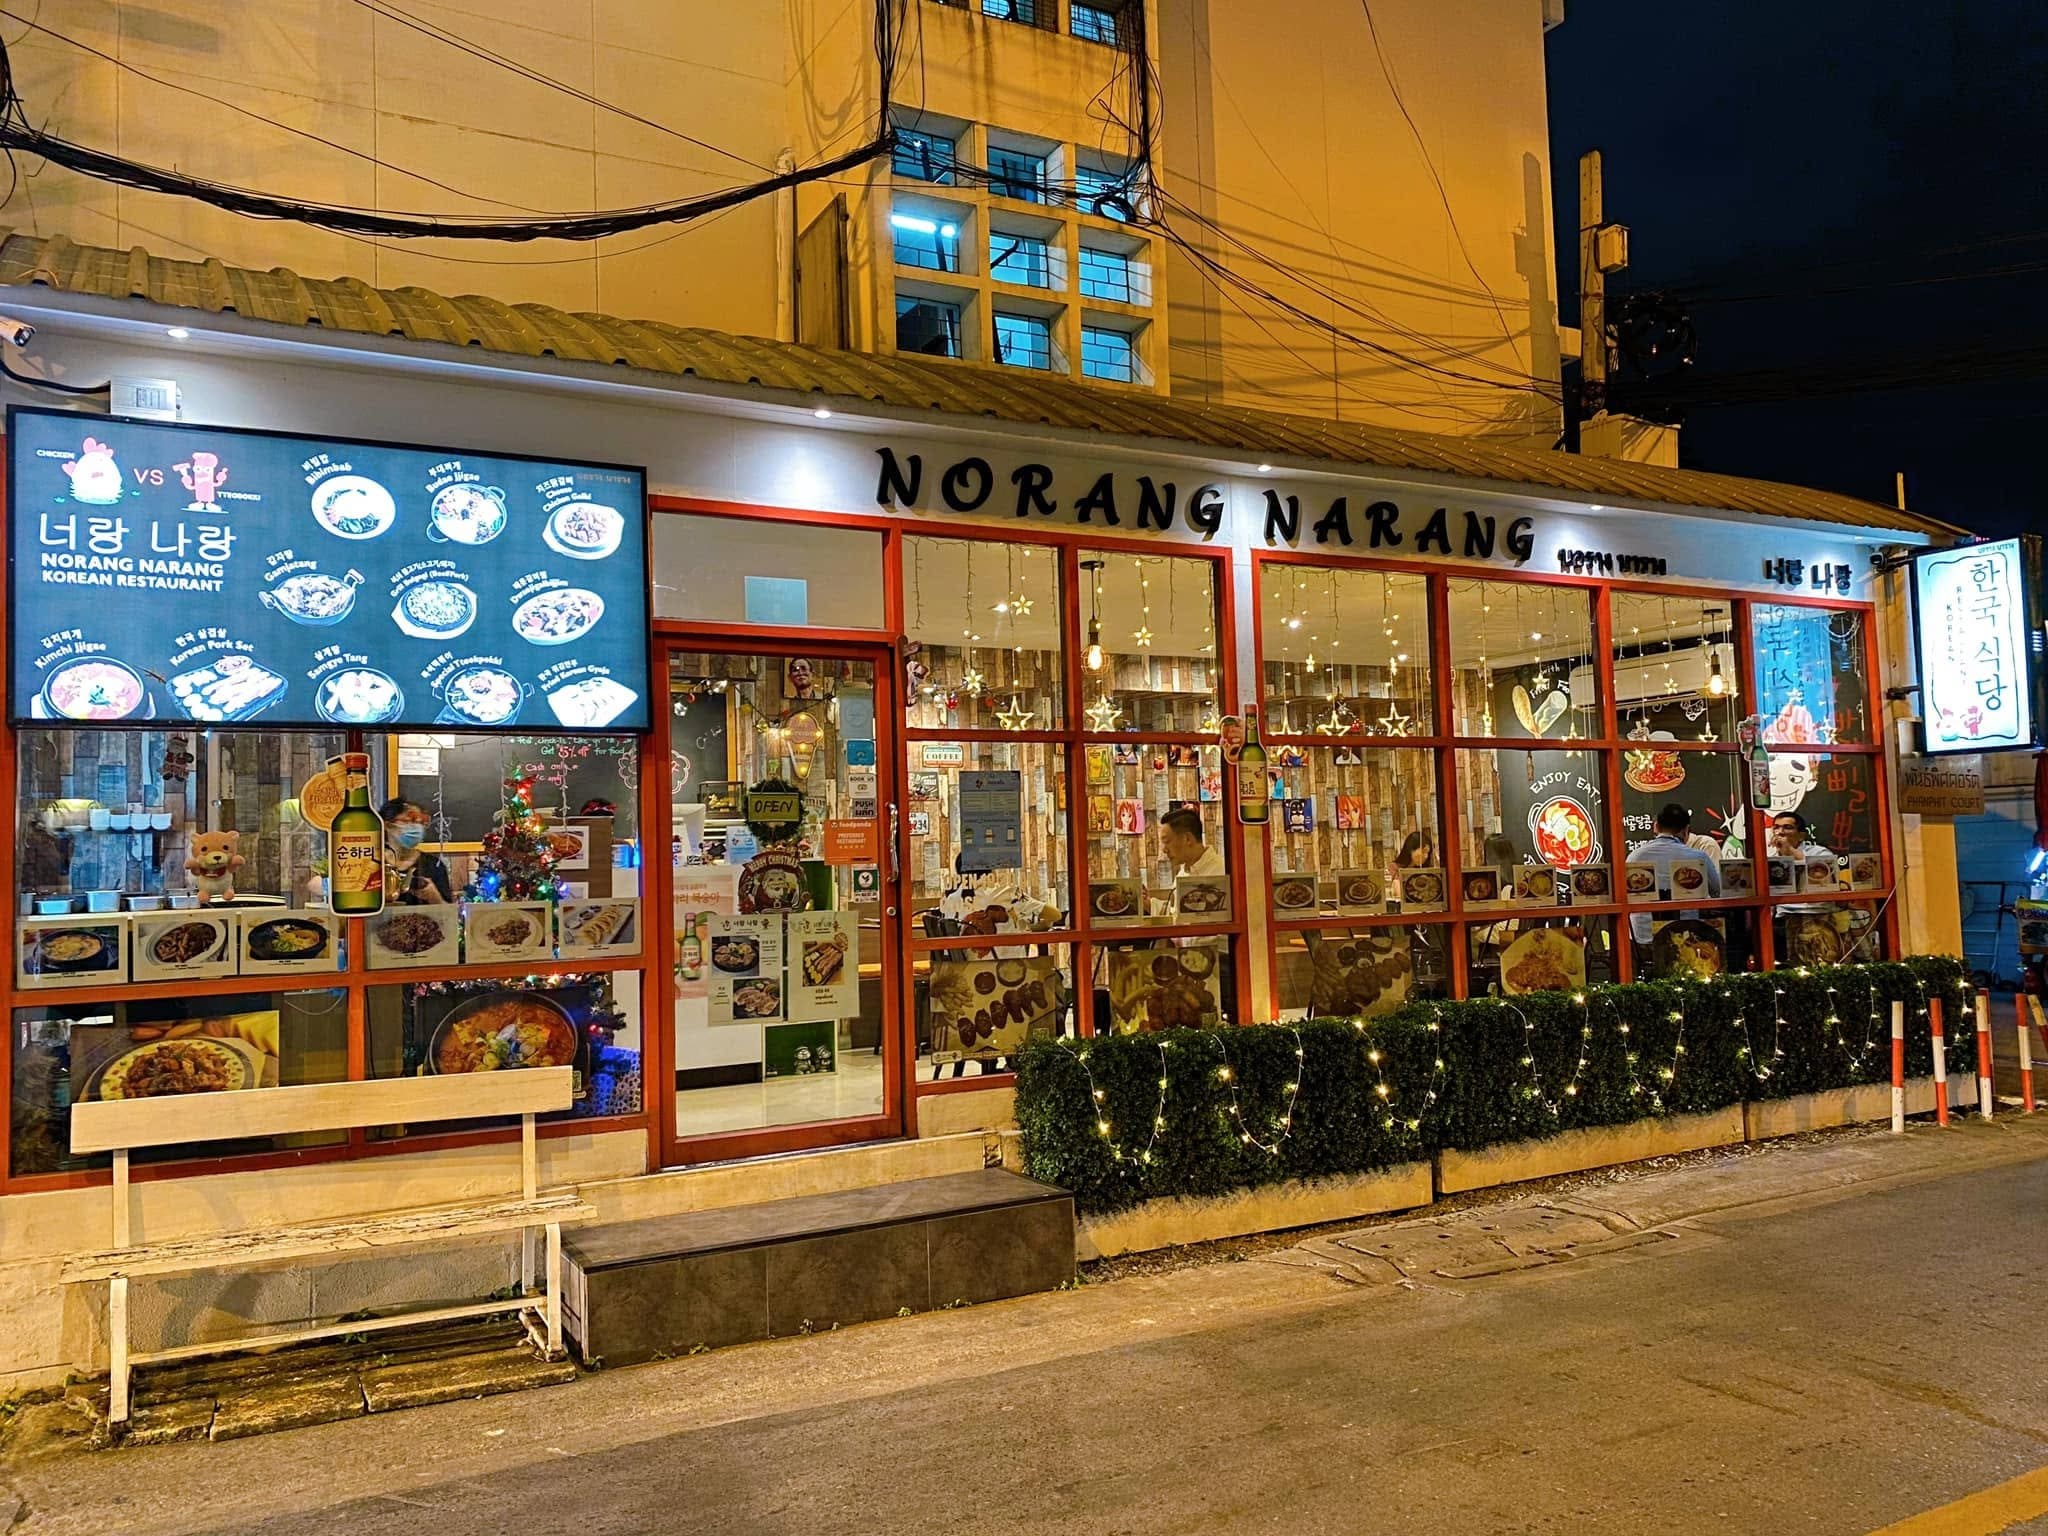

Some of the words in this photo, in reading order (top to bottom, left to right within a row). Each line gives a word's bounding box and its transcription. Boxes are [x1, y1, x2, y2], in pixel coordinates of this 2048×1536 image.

[133, 468, 164, 486] VS
[875, 446, 1225, 542] NORANG
[1264, 488, 1535, 567] NARANG
[39, 513, 130, 554] 너랑
[151, 521, 238, 562] 나랑
[41, 553, 133, 572] NORANG
[139, 558, 224, 578] NARANG
[1763, 557, 1805, 586] 너랑
[1811, 562, 1853, 591] 나랑
[42, 570, 113, 586] KOREAN
[116, 573, 224, 593] RESTAURANT
[1969, 559, 2002, 628] 한국
[34, 641, 73, 670] Kimchi
[169, 643, 207, 667] Korean
[207, 639, 233, 651] Pork
[235, 640, 255, 653] Set
[342, 653, 369, 665] Tang
[1974, 636, 2008, 711] 식당
[525, 763, 545, 772] Cash
[1530, 770, 1572, 795] ENJOY
[1576, 776, 1602, 806] EAT!
[755, 800, 794, 813] OPEN
[839, 821, 872, 829] foodpanda
[336, 846, 375, 860] 순하리
